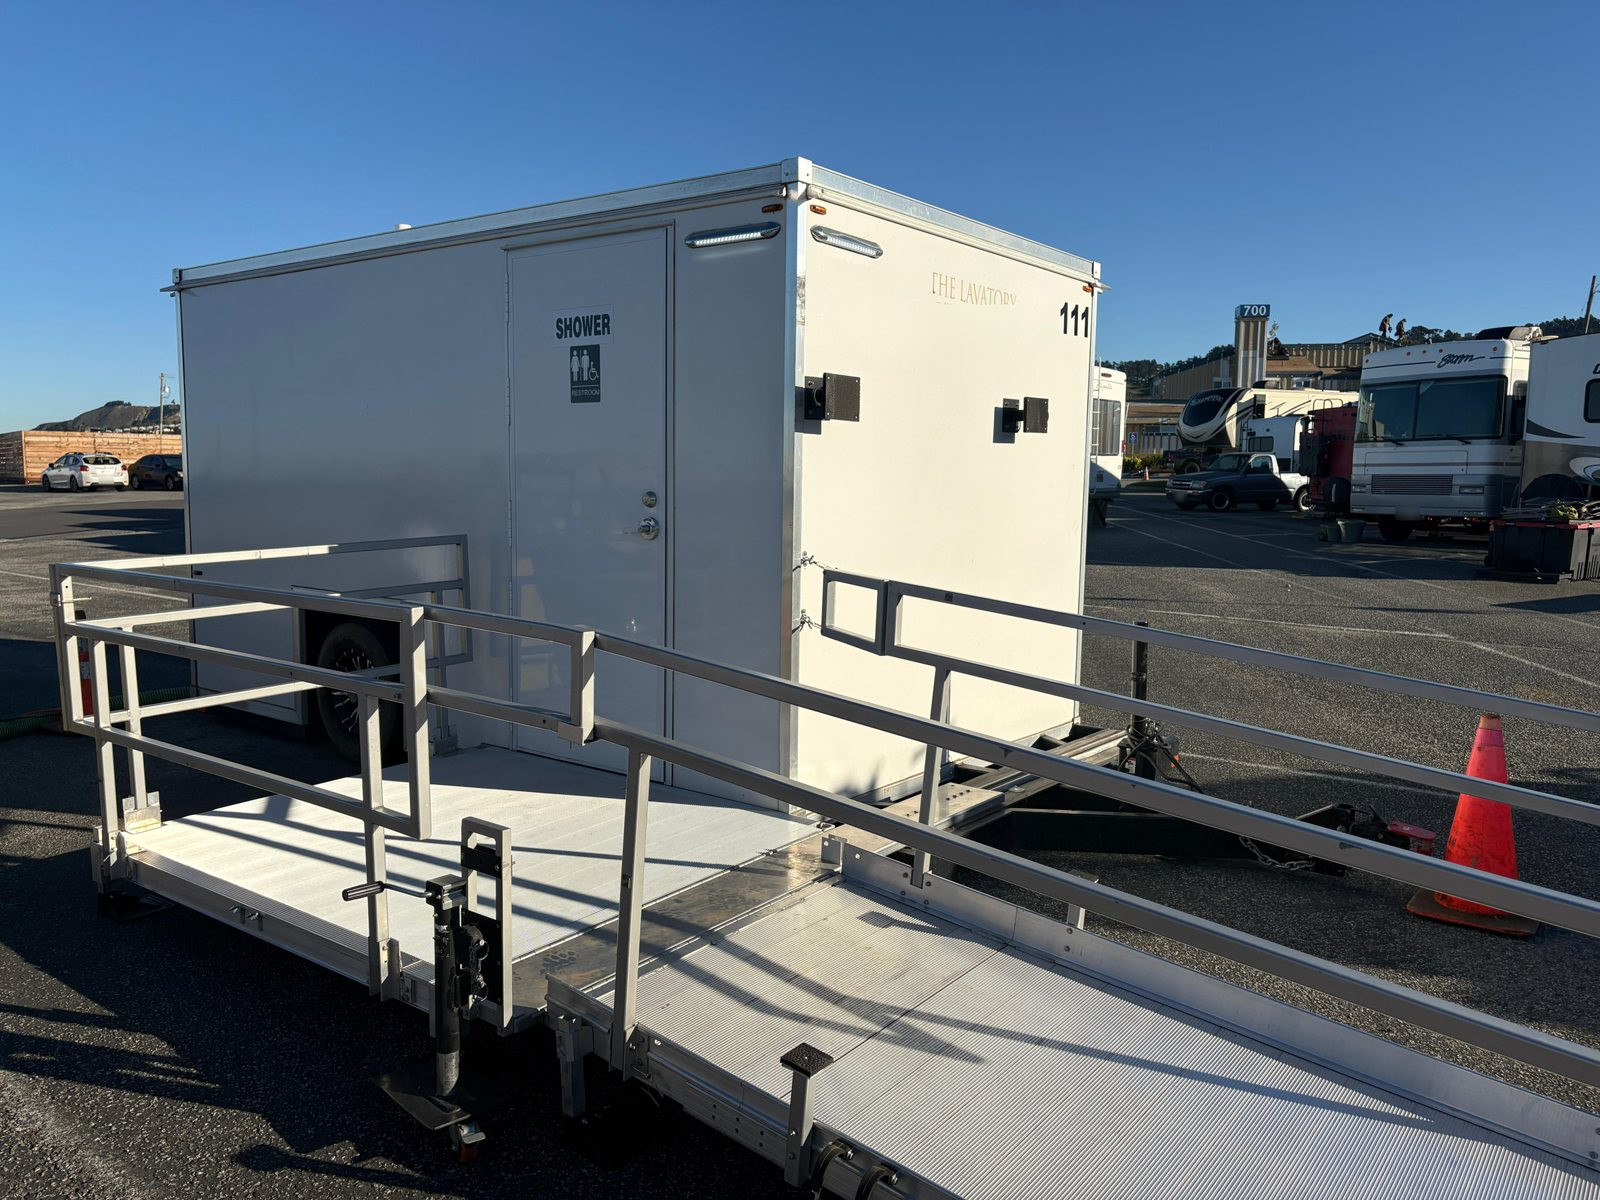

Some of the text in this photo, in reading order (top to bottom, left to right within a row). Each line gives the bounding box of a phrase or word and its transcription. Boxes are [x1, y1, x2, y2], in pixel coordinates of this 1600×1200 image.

[1060, 301, 1089, 338] 111
[1243, 305, 1267, 317] 700
[556, 313, 610, 340] SHOWER
